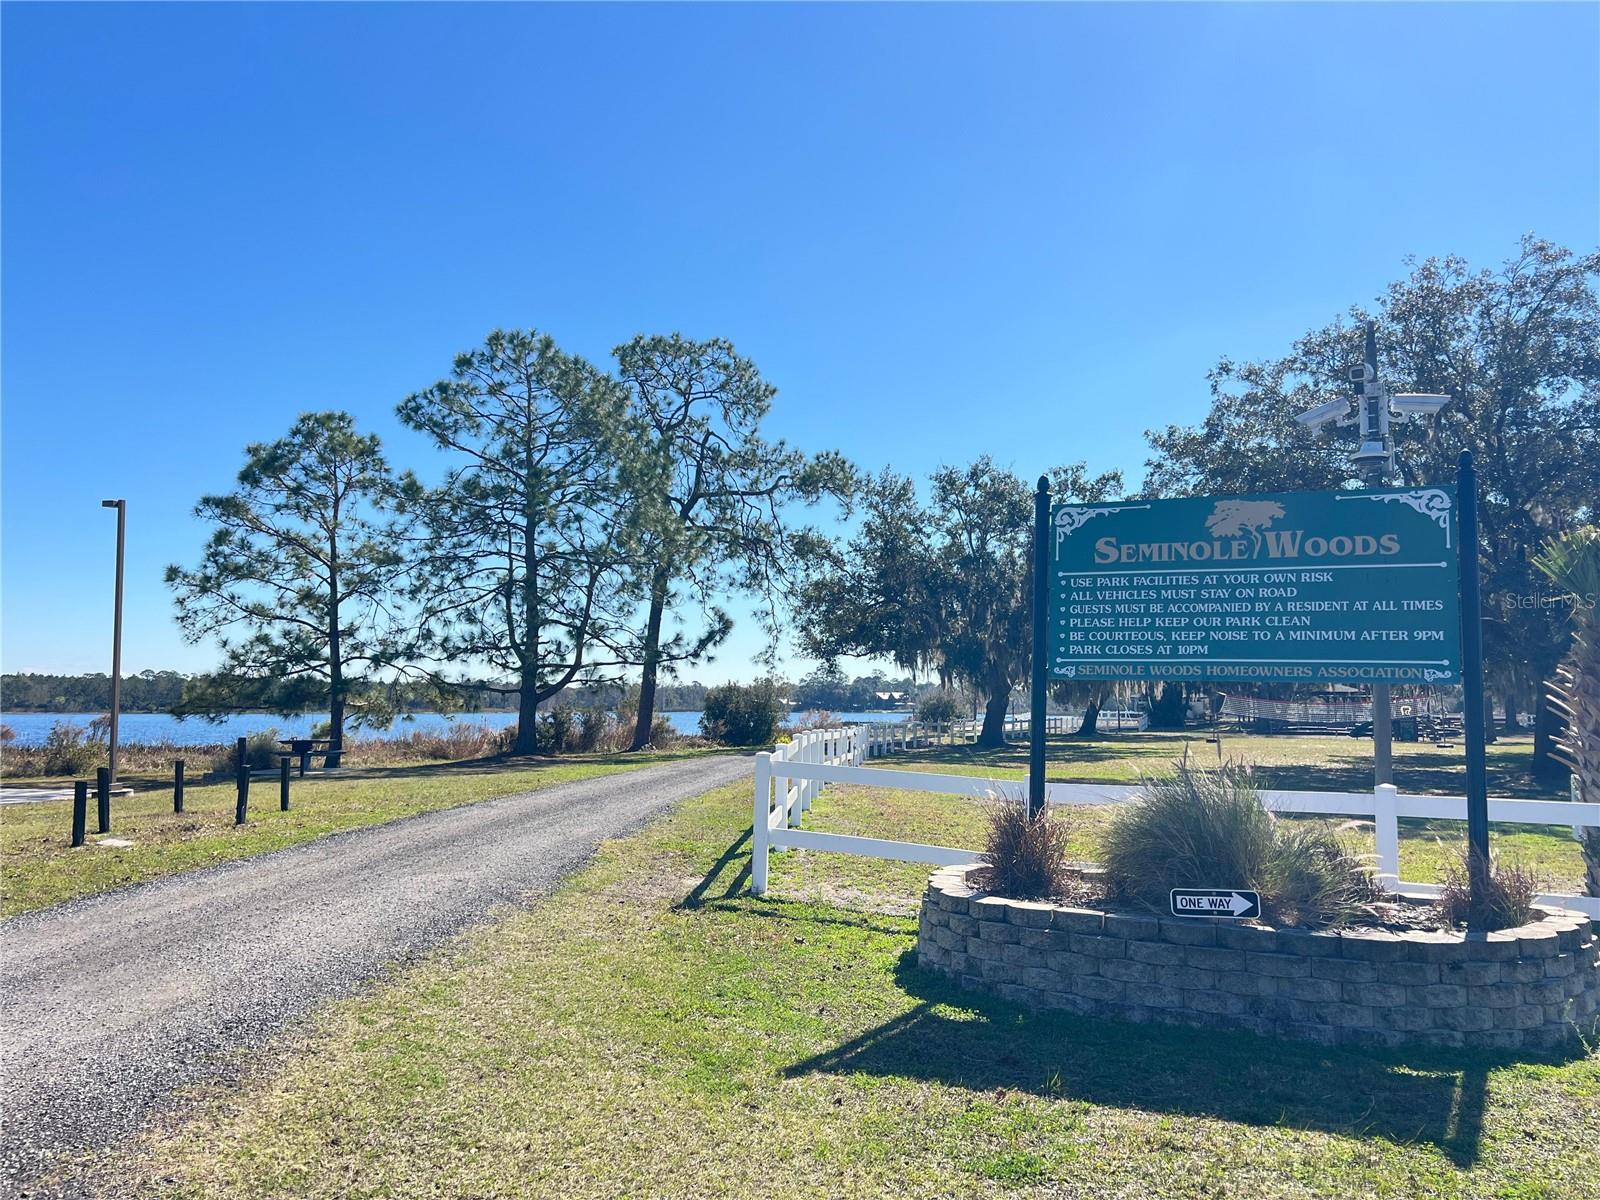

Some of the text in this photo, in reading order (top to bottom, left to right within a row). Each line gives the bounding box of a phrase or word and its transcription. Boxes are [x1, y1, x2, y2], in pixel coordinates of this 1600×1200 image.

[1095, 530, 1400, 564] SEMINOLE WOODS
[1071, 572, 1333, 587] USE PARK FACILITIES AT YOUR OWN RISK
[1070, 588, 1297, 601] ALL VEHICLES MUST STAY ON ROAD
[1070, 600, 1443, 613] GUESTS MUST BE ACCOMPANIED BY A RESIDENT AT ALL TIMES
[1070, 616, 1310, 627] PLEASE HELP KEEP OUR PARK CLEAN
[1070, 631, 1444, 641] BE COURTEOUS, KEEP NOISE TO A MINIMUM AFTER 9PM
[1069, 645, 1208, 654] PARK CLOSES AT 10PM
[1078, 665, 1422, 679] SEMINOLE WOODS HOMEOWNERS ASSOCIATION
[1180, 897, 1231, 909] ONE WAY
